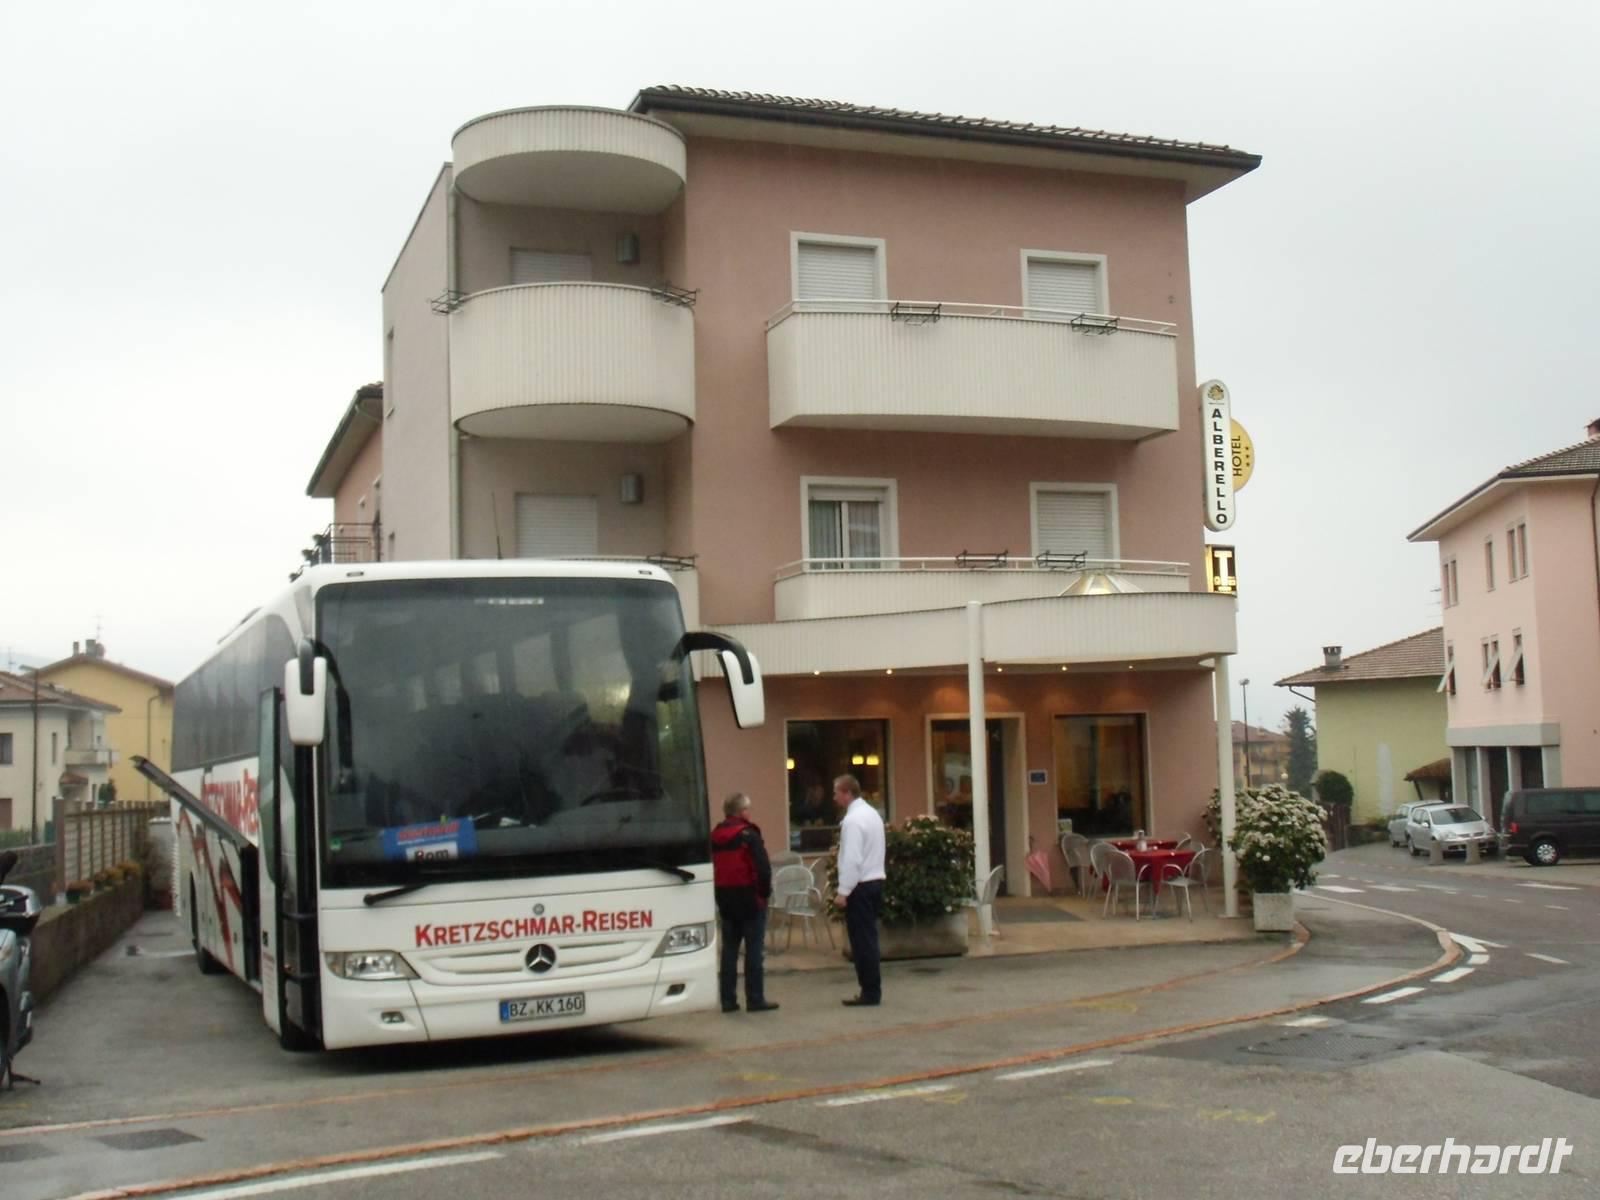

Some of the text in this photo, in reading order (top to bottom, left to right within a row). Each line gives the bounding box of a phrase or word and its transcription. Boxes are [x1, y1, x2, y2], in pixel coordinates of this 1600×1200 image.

[1211, 408, 1228, 524] ALBERELLO
[1230, 435, 1243, 477] HOTEL
[510, 996, 582, 1017] BZ KK 160
